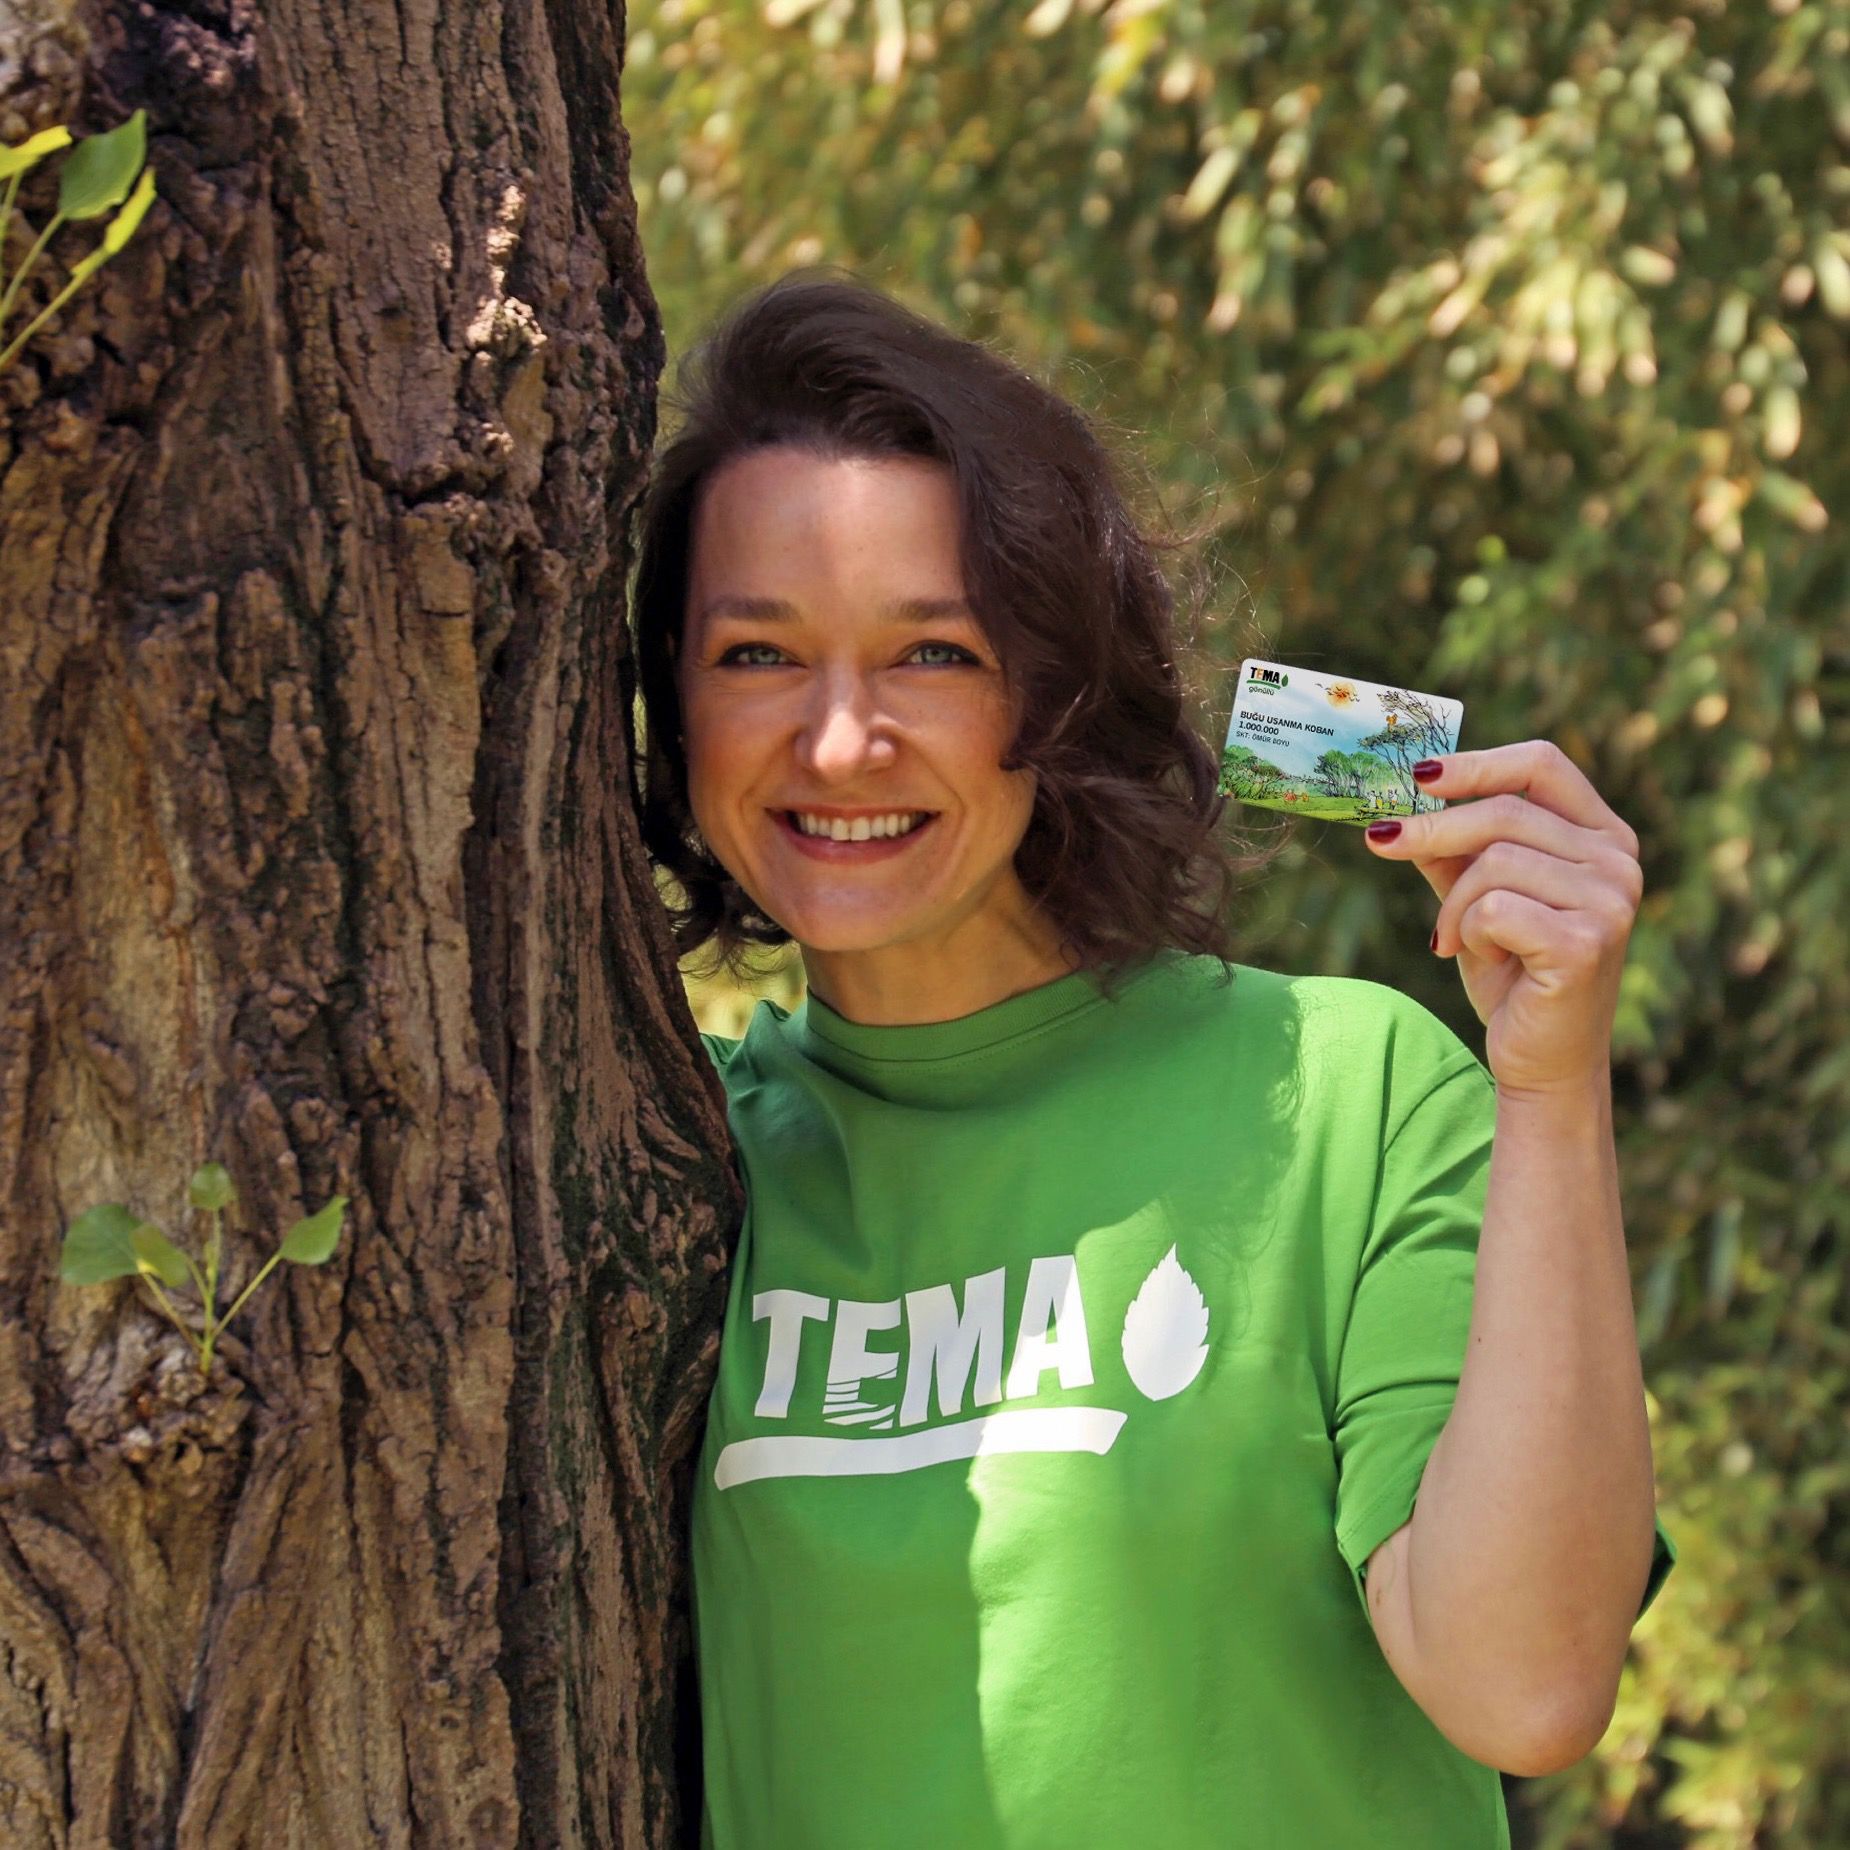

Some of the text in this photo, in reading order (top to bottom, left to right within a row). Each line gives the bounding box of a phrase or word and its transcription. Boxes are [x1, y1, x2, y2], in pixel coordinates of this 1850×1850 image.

[1250, 667, 1280, 684] TEMA
[1248, 686, 1275, 696] gönüllü
[1239, 721, 1280, 735] 1.000.000
[1240, 711, 1335, 736] BUĞU USANMA KOBAN
[1236, 731, 1250, 740] SKT:
[752, 1254, 1095, 1430] TEMA
